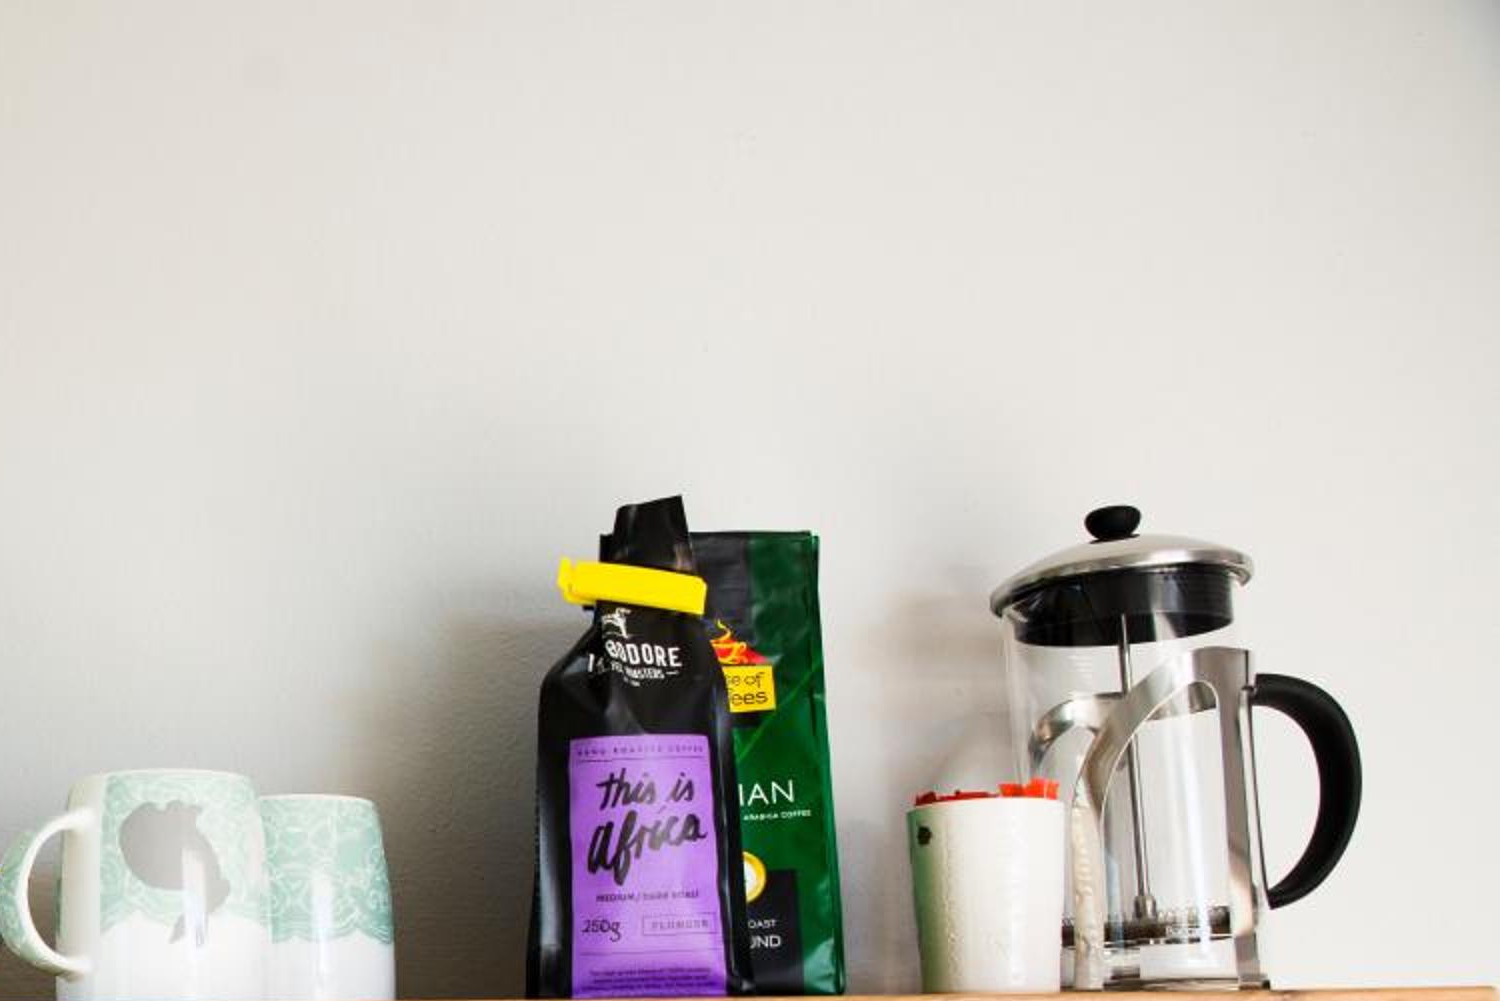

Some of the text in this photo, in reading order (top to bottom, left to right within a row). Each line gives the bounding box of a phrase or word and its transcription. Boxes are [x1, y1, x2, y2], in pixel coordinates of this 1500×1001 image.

[743, 671, 766, 689] of
[730, 691, 769, 706] ees
[596, 767, 694, 811] this is
[737, 779, 795, 807] IAN
[779, 808, 812, 819] COFFEE
[581, 918, 622, 943] 250g
[746, 919, 777, 929] OAST
